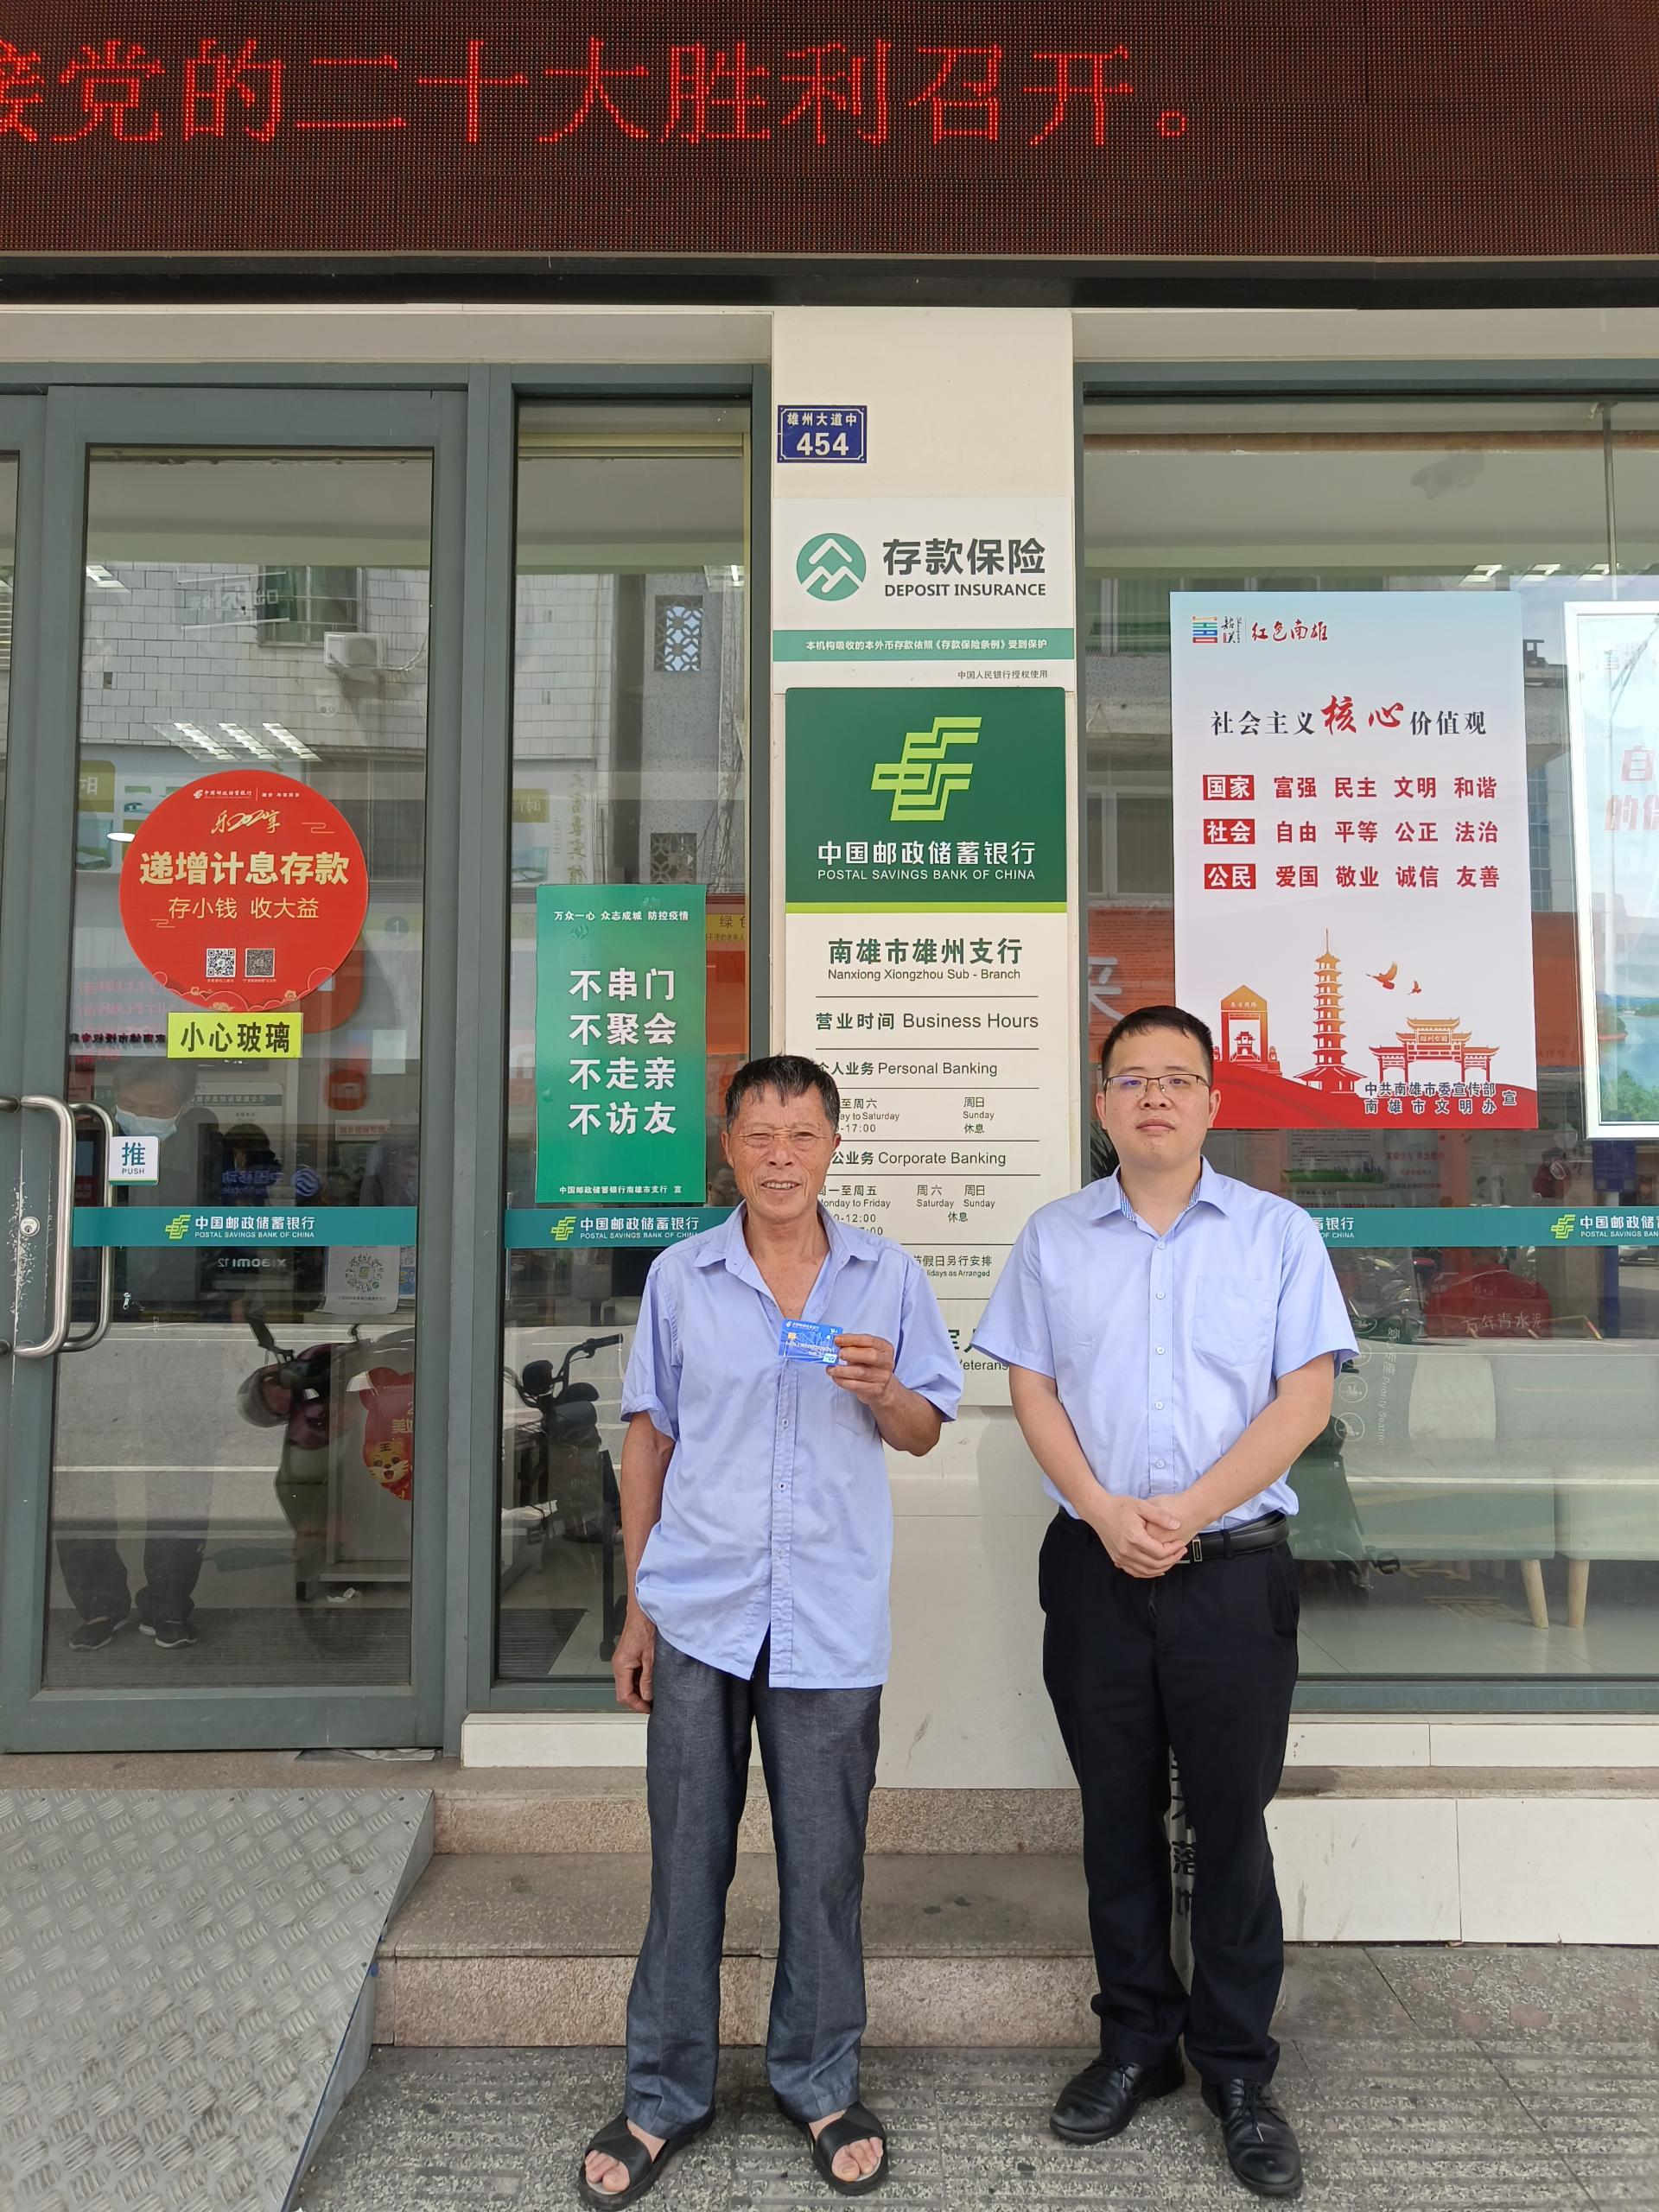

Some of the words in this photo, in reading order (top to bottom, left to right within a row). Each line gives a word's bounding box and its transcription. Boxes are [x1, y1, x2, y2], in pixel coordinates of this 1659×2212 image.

[787, 412, 858, 427] 雄州大道中
[796, 433, 849, 456] 454
[882, 537, 1046, 575] 存款保险
[884, 584, 950, 596] DEPOSIT
[954, 584, 1046, 596] INSURANCE
[1252, 616, 1328, 642] 红色南雄
[806, 639, 1047, 651] 本机构吸收的本外币存款依照《存款保险条例》受到保护
[957, 670, 1048, 680] 中国人民银行授权使用
[1211, 695, 1487, 735] 社会主义核心价值观
[1207, 778, 1250, 798] 国家
[1274, 777, 1318, 798] 富强
[1334, 777, 1377, 798] 民主
[1394, 777, 1437, 798] 文明
[1453, 777, 1497, 798] 和谐
[1206, 821, 1251, 843] 社会
[1276, 821, 1317, 842] 自由
[1335, 821, 1378, 842] 平等
[1395, 821, 1439, 842] 公正
[1455, 821, 1498, 842] 法治
[817, 841, 1036, 865] 中国邮政储蓄银行
[140, 851, 350, 886] 递增计息存款
[817, 869, 867, 880] POSTAL
[872, 869, 928, 880] SAVINGS
[933, 869, 968, 880] BANK
[973, 869, 989, 880] OF
[995, 869, 1035, 880] CHINA
[1208, 867, 1252, 888] 公民
[1275, 866, 1319, 888] 爱国
[1336, 866, 1379, 888] 敬业
[1395, 866, 1439, 888] 诚信
[1456, 866, 1499, 888] 友善
[168, 897, 238, 919] 存小钱
[251, 897, 320, 919] 收大益
[554, 911, 595, 921] 万众一心
[601, 911, 642, 921] 众志成城
[647, 911, 690, 921] 防控疫情
[829, 938, 1022, 965] 南雄市雄州支行
[828, 969, 881, 982] Nanxiong
[884, 969, 944, 982] Xiongzhou
[947, 969, 969, 980] Sub
[981, 969, 1021, 980] Branch
[569, 968, 675, 1001] 不串门
[816, 1013, 895, 1031] 营业时间
[903, 1013, 982, 1029] Business
[988, 1013, 1039, 1029] Hours
[569, 1013, 677, 1046] 不聚会
[181, 1021, 290, 1053] 小心玻璃
[569, 1057, 677, 1090] 不走亲
[878, 1063, 938, 1075] Personal
[943, 1063, 997, 1077] Banking
[1364, 1082, 1496, 1096] 中共南雄市委宣传部
[964, 1097, 984, 1108] 周日
[1503, 1091, 1516, 1106] 宣
[1364, 1100, 1497, 1114] 南雄市文明办
[569, 1102, 677, 1135] 不访友
[862, 1112, 899, 1122] Saturday
[963, 1111, 995, 1121] Sunday
[964, 1123, 984, 1134] 休息
[122, 1142, 146, 1166] 推
[879, 1152, 946, 1166] Corporate
[951, 1152, 1007, 1166] Banking
[559, 1185, 668, 1194] 中国邮政储蓄银行南雄市支行
[673, 1185, 682, 1194] 宣
[917, 1185, 942, 1196] 周六
[964, 1185, 985, 1196] 周日
[821, 1199, 849, 1209] onday
[863, 1199, 891, 1209] Friday
[917, 1199, 954, 1209] Saturday
[963, 1199, 995, 1209] Sunday
[195, 1216, 315, 1230] 中国邮政储蓄银行
[948, 1211, 969, 1222] 休息
[1580, 1215, 1659, 1229] 中国邮政储
[580, 1217, 699, 1231] 中国邮政储蓄银行
[957, 1269, 990, 1279] Arranged
[960, 1359, 1008, 1370] eterans
